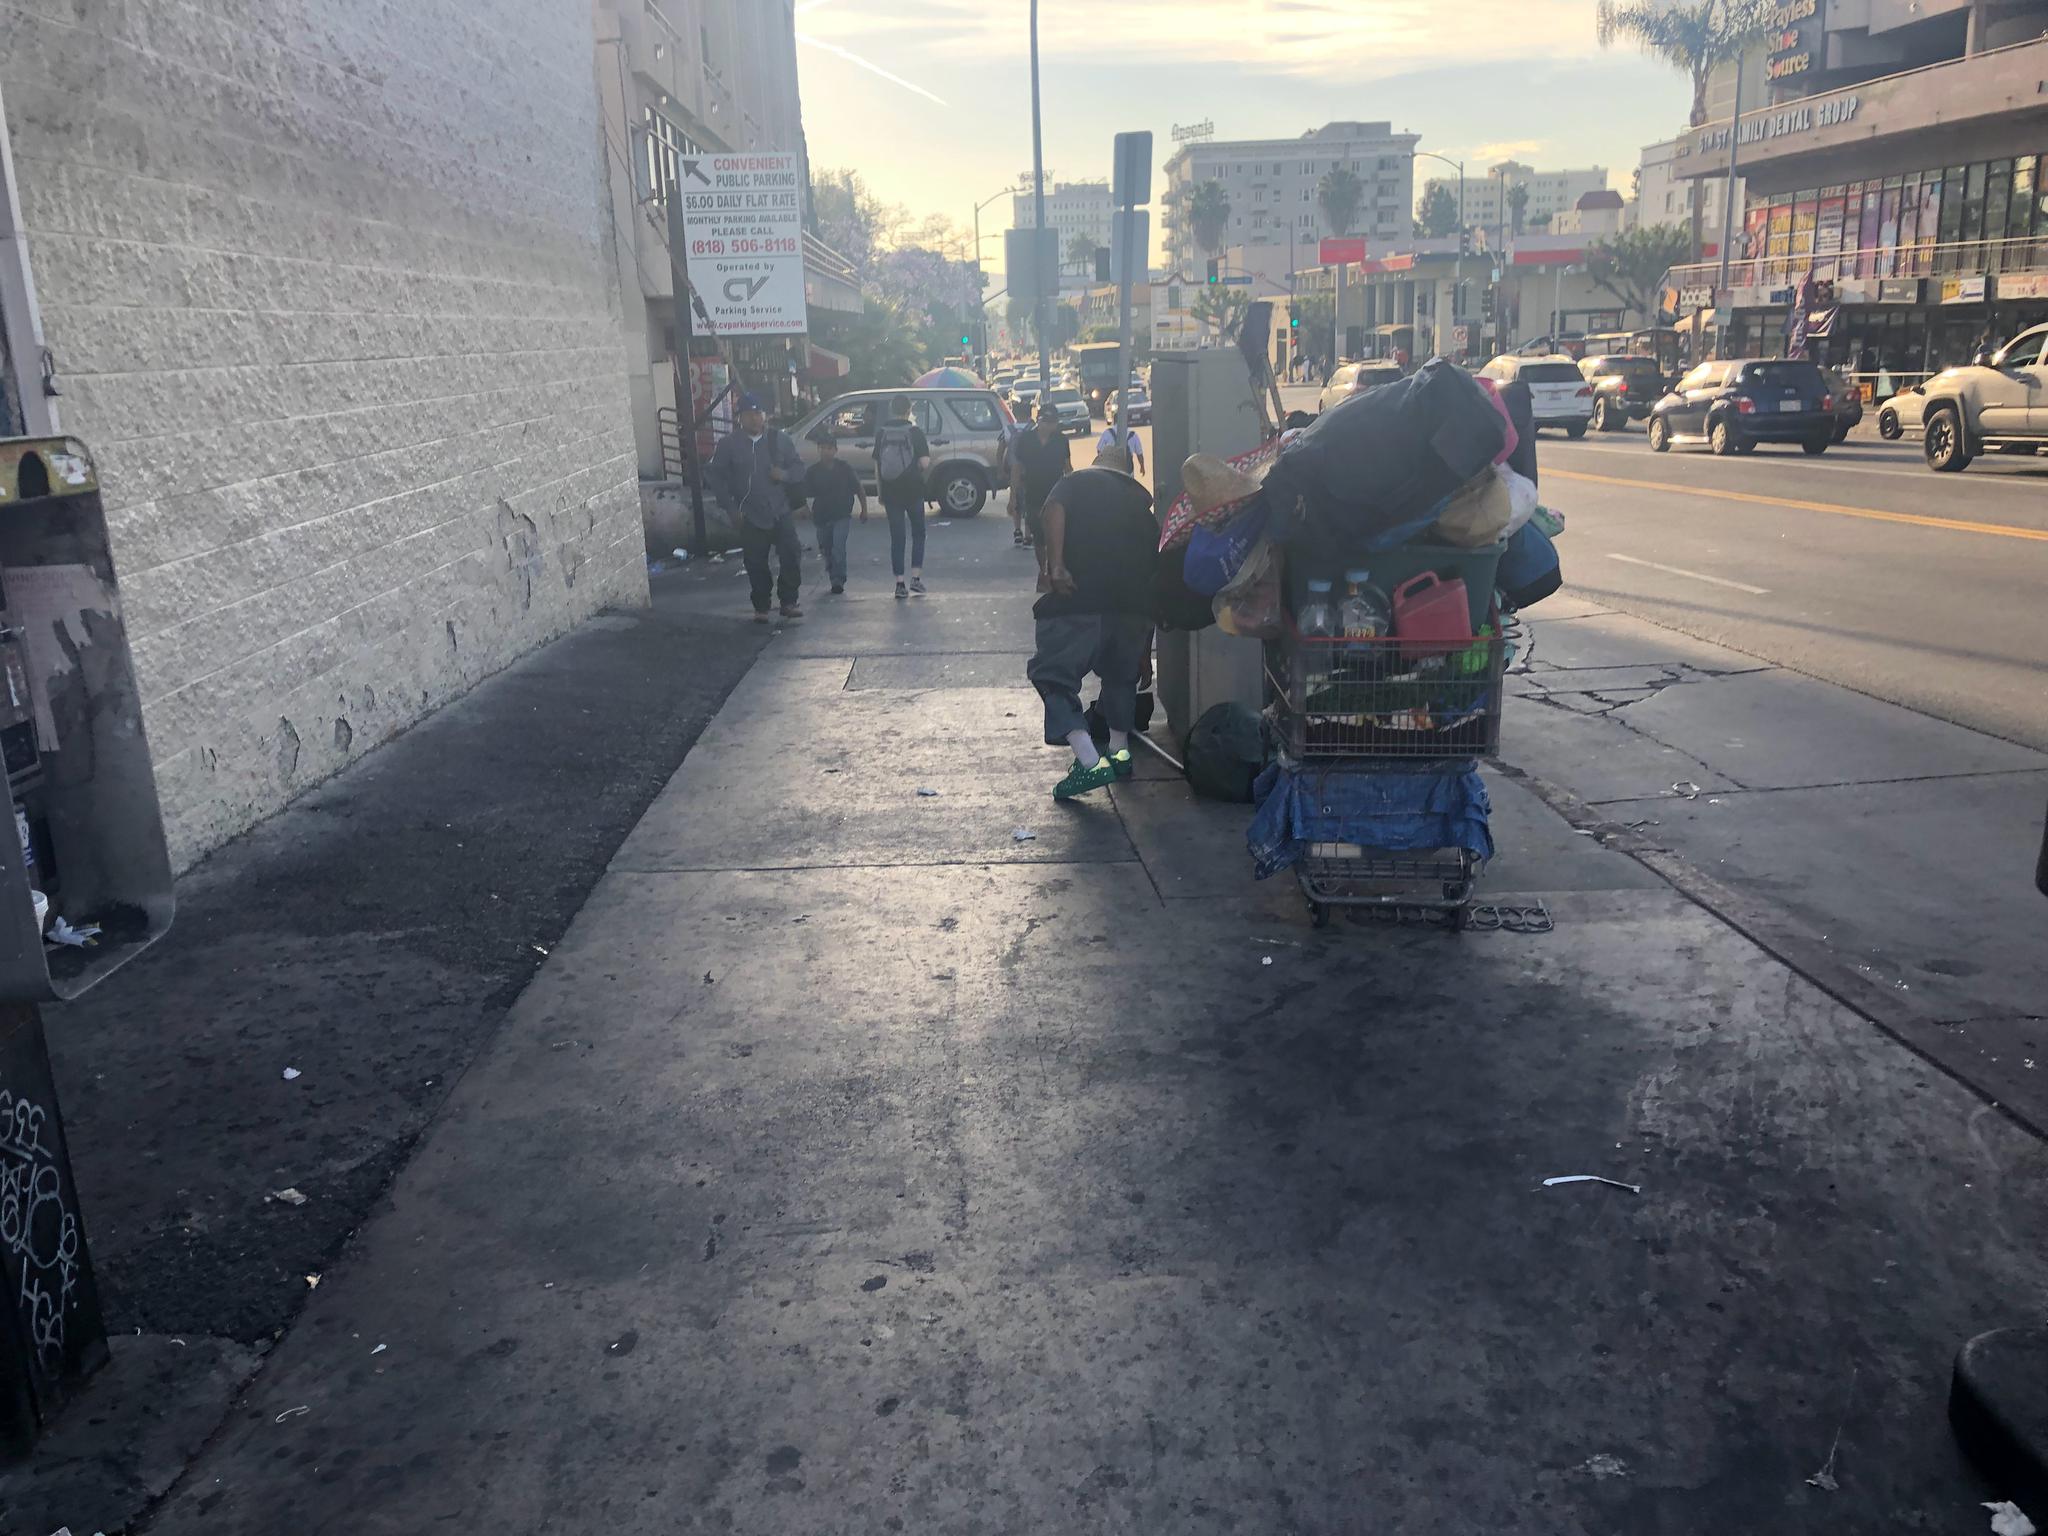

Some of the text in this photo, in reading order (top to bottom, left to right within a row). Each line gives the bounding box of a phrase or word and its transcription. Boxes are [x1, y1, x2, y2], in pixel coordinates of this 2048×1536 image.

[1768, 29, 1799, 54] Shoe
[1765, 51, 1809, 80] Source
[1769, 107, 1811, 139] DENTAL
[1816, 95, 1859, 127] GROUP
[1171, 116, 1214, 142] Ansonia
[713, 157, 793, 171] CONVENIENT
[715, 172, 796, 188] PUBLIC PARKING
[686, 193, 797, 210] $6.00 DAILY FLAT RATE
[687, 214, 798, 225] MONTHLY PARKING AVAILABLE
[712, 227, 775, 237] PLEASE CALL
[692, 238, 797, 255] (818) 506-8118
[716, 263, 775, 272] Operated by
[1680, 285, 1712, 308] boost
[715, 306, 783, 316] Parking Service
